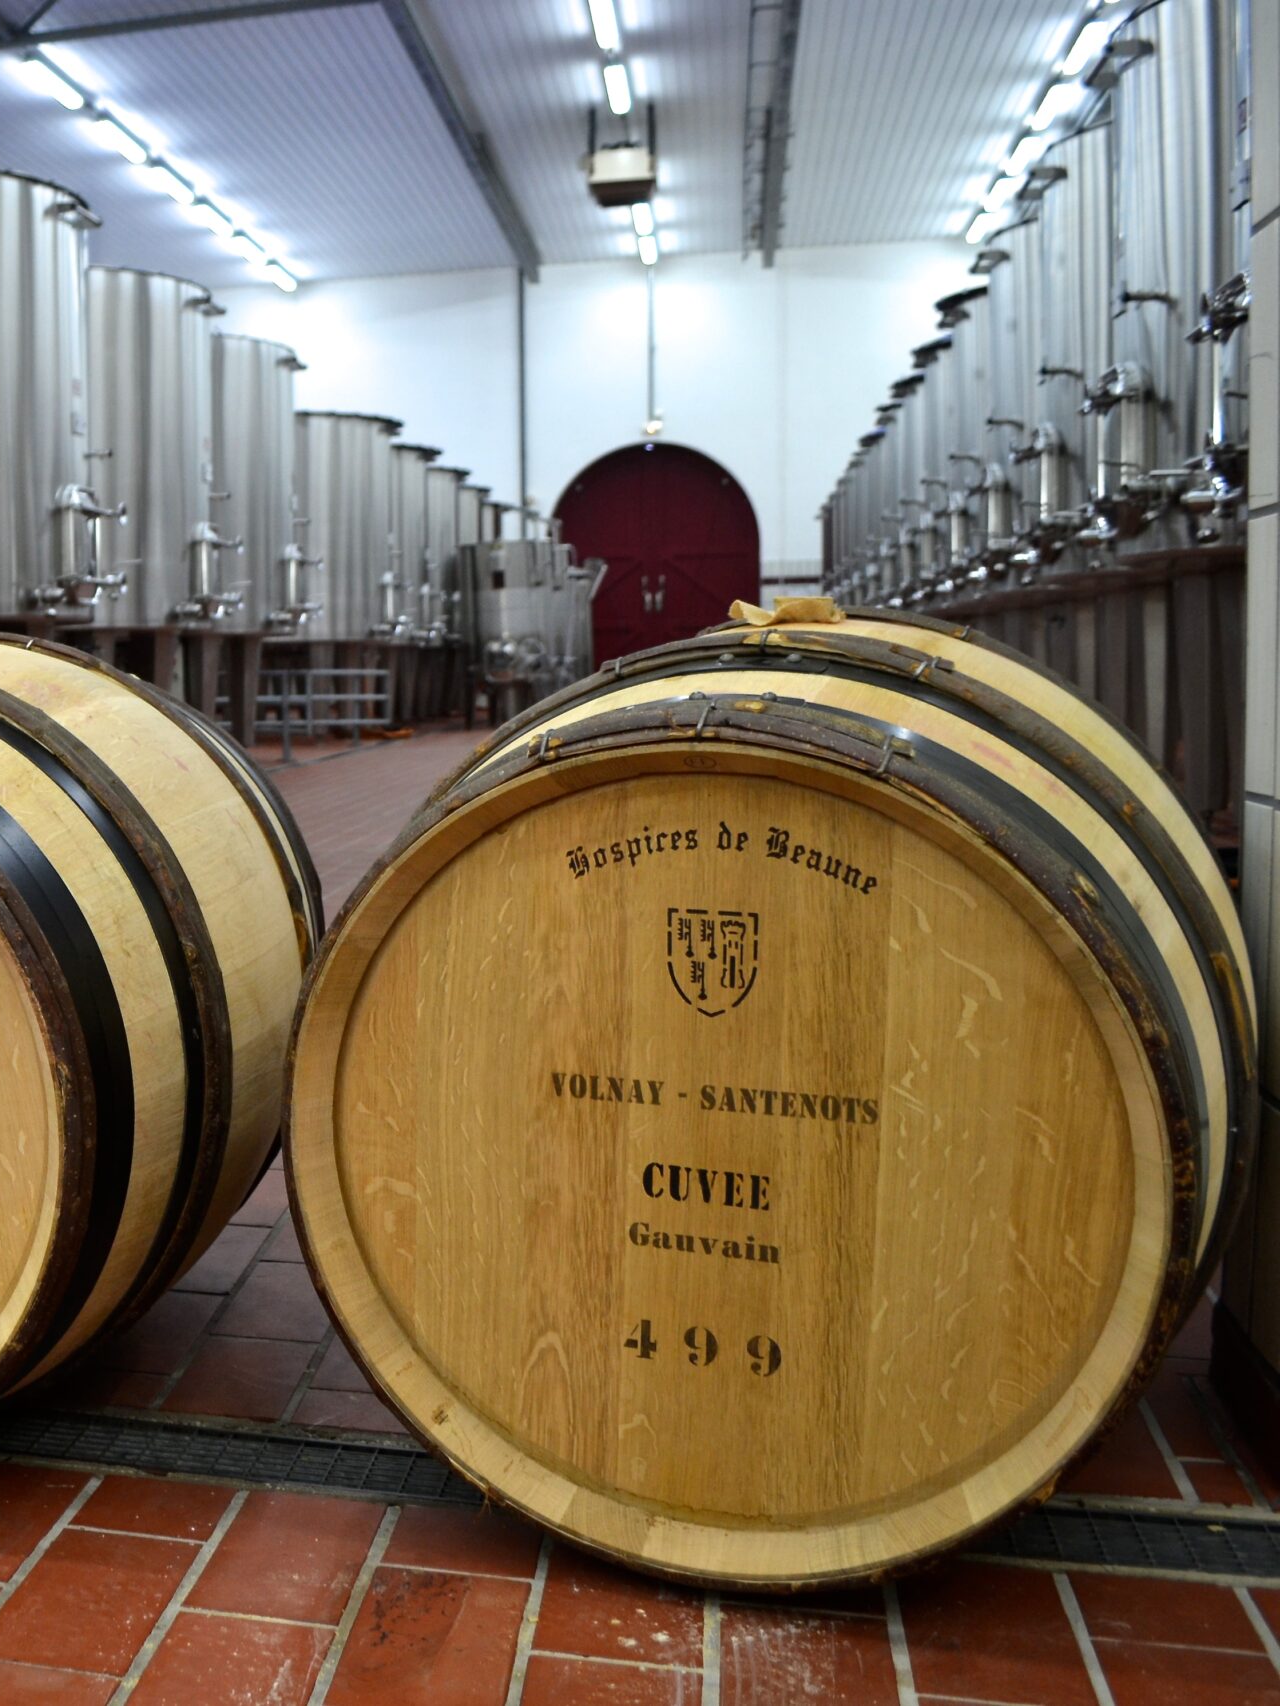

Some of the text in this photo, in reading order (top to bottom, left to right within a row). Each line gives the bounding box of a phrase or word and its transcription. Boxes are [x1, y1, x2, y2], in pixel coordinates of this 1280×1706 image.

[567, 821, 878, 896] Hospices de Beaune
[551, 1072, 665, 1106] VOLNAY
[700, 1084, 880, 1126] SANTENOTS
[642, 1162, 771, 1212] CUVEE
[628, 1221, 780, 1265] Gauvain
